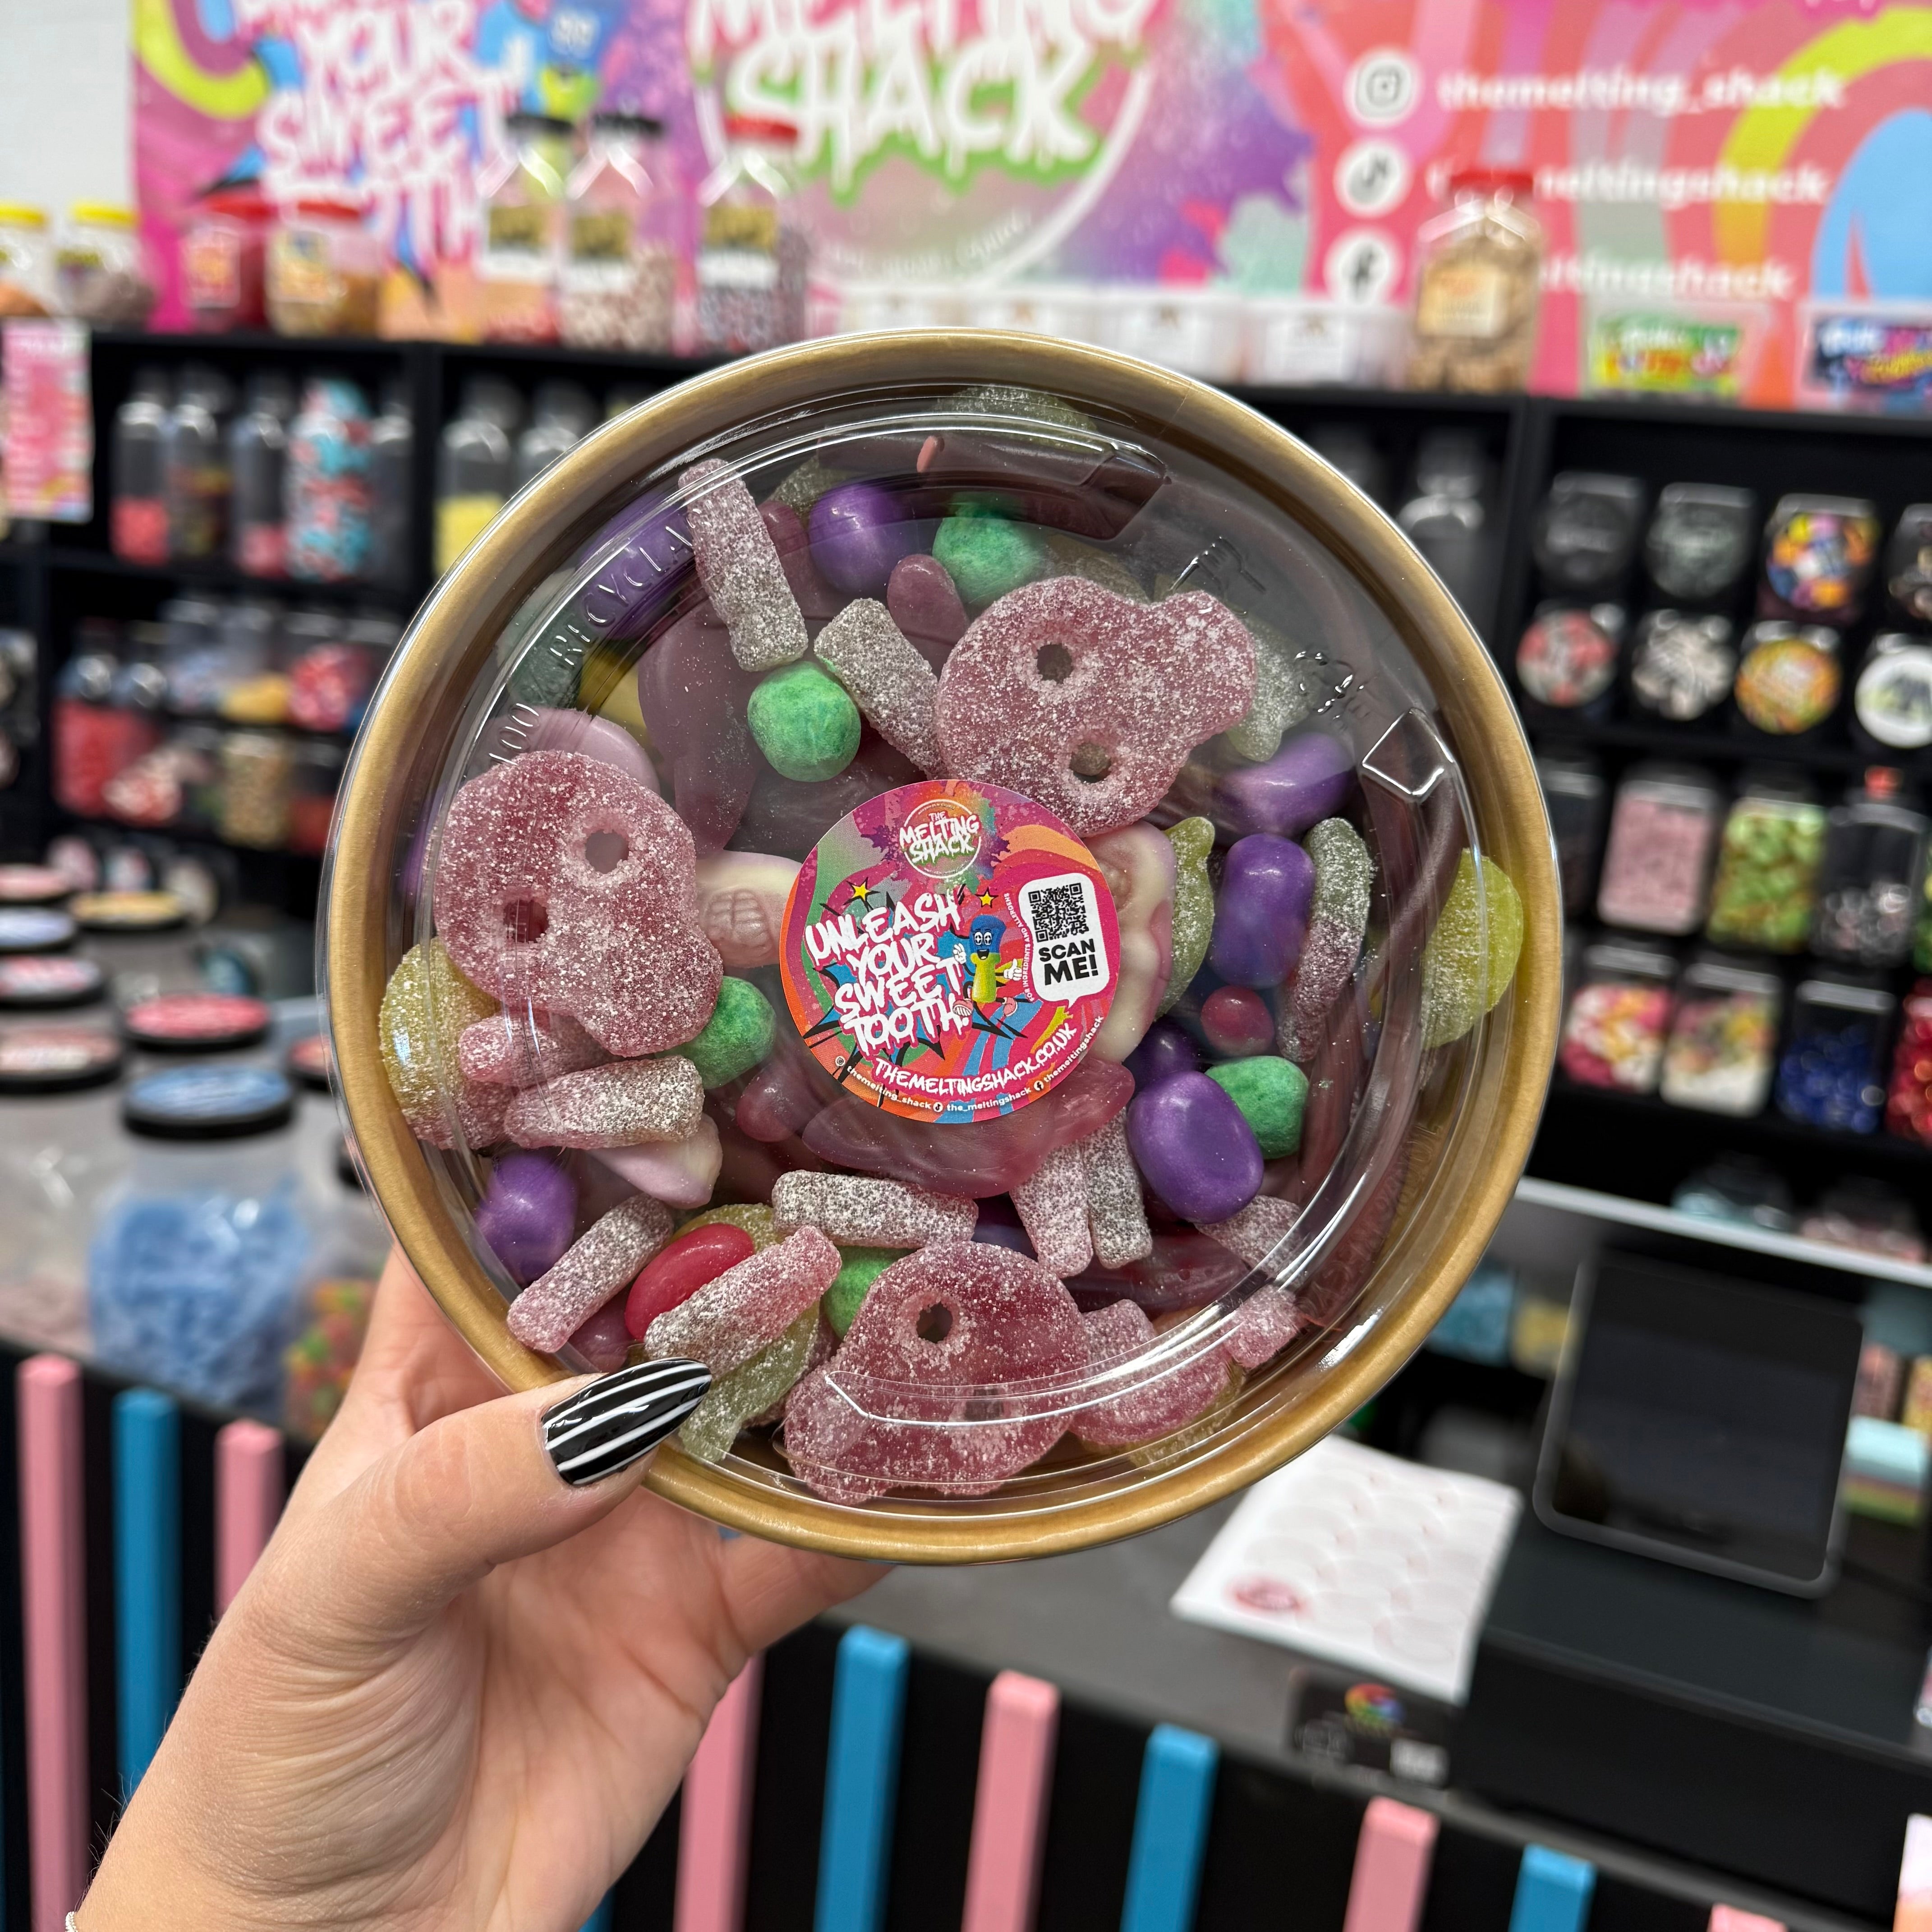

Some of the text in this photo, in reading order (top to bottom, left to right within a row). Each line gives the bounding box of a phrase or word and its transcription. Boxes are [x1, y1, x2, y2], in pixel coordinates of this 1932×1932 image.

[257, 73, 523, 180] SWEET
[726, 31, 1095, 192] SHACK
[899, 814, 980, 848] MELTING
[929, 811, 946, 821] THE
[909, 833, 975, 863] SHACK
[805, 889, 960, 966] UNLEASH
[1021, 928, 1030, 942] AND
[846, 933, 941, 983] YOUR
[1039, 938, 1095, 962] SCAN
[1044, 954, 1098, 985] ME!
[835, 957, 963, 1023] SWEET
[1024, 988, 1035, 1002] FOR
[876, 1023, 1077, 1096] THEMELTINGSHACK.CO.UK
[1043, 1016, 1104, 1083] themeltingshack
[847, 1066, 931, 1109] themelting_shack
[947, 1087, 1032, 1111] the_meltingshack
